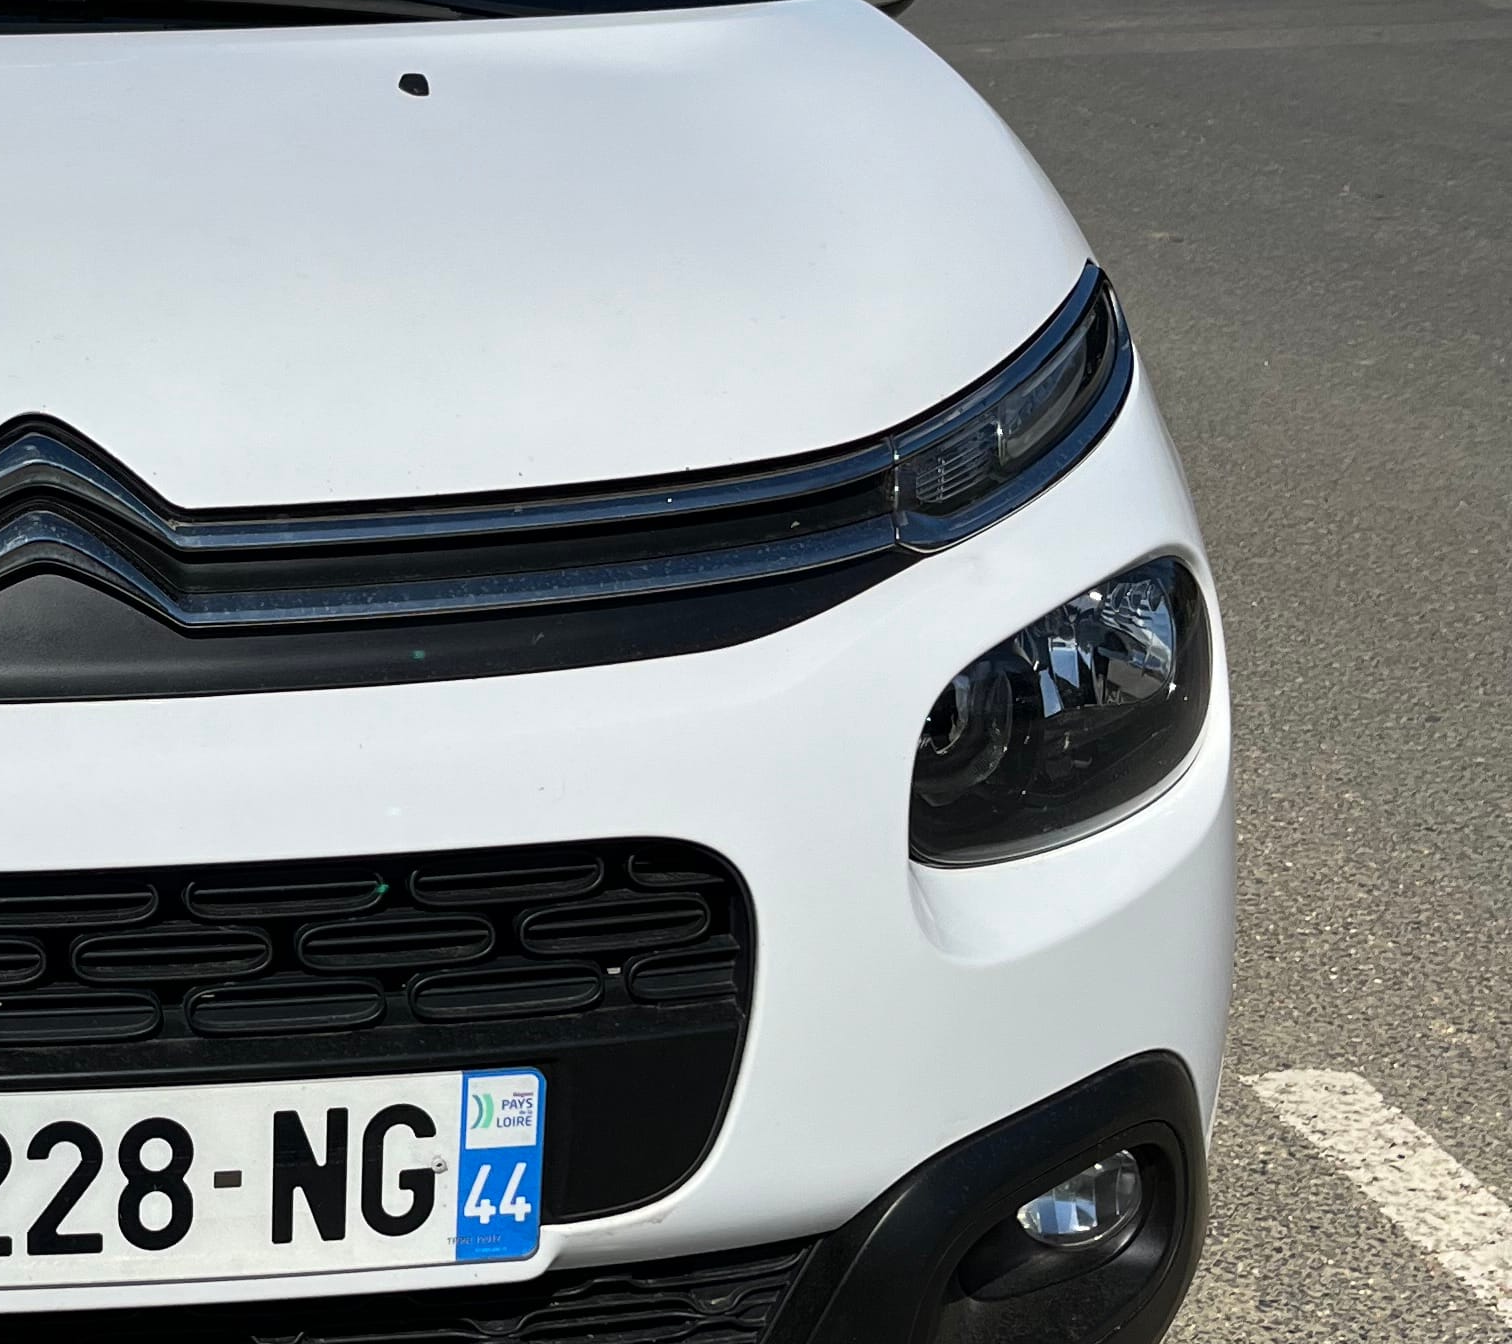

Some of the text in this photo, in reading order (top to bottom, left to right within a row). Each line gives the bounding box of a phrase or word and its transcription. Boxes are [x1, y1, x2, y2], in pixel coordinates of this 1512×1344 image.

[502, 1098, 533, 1110] PAYS
[496, 1115, 532, 1128] LOIRE
[463, 1162, 532, 1225] 44
